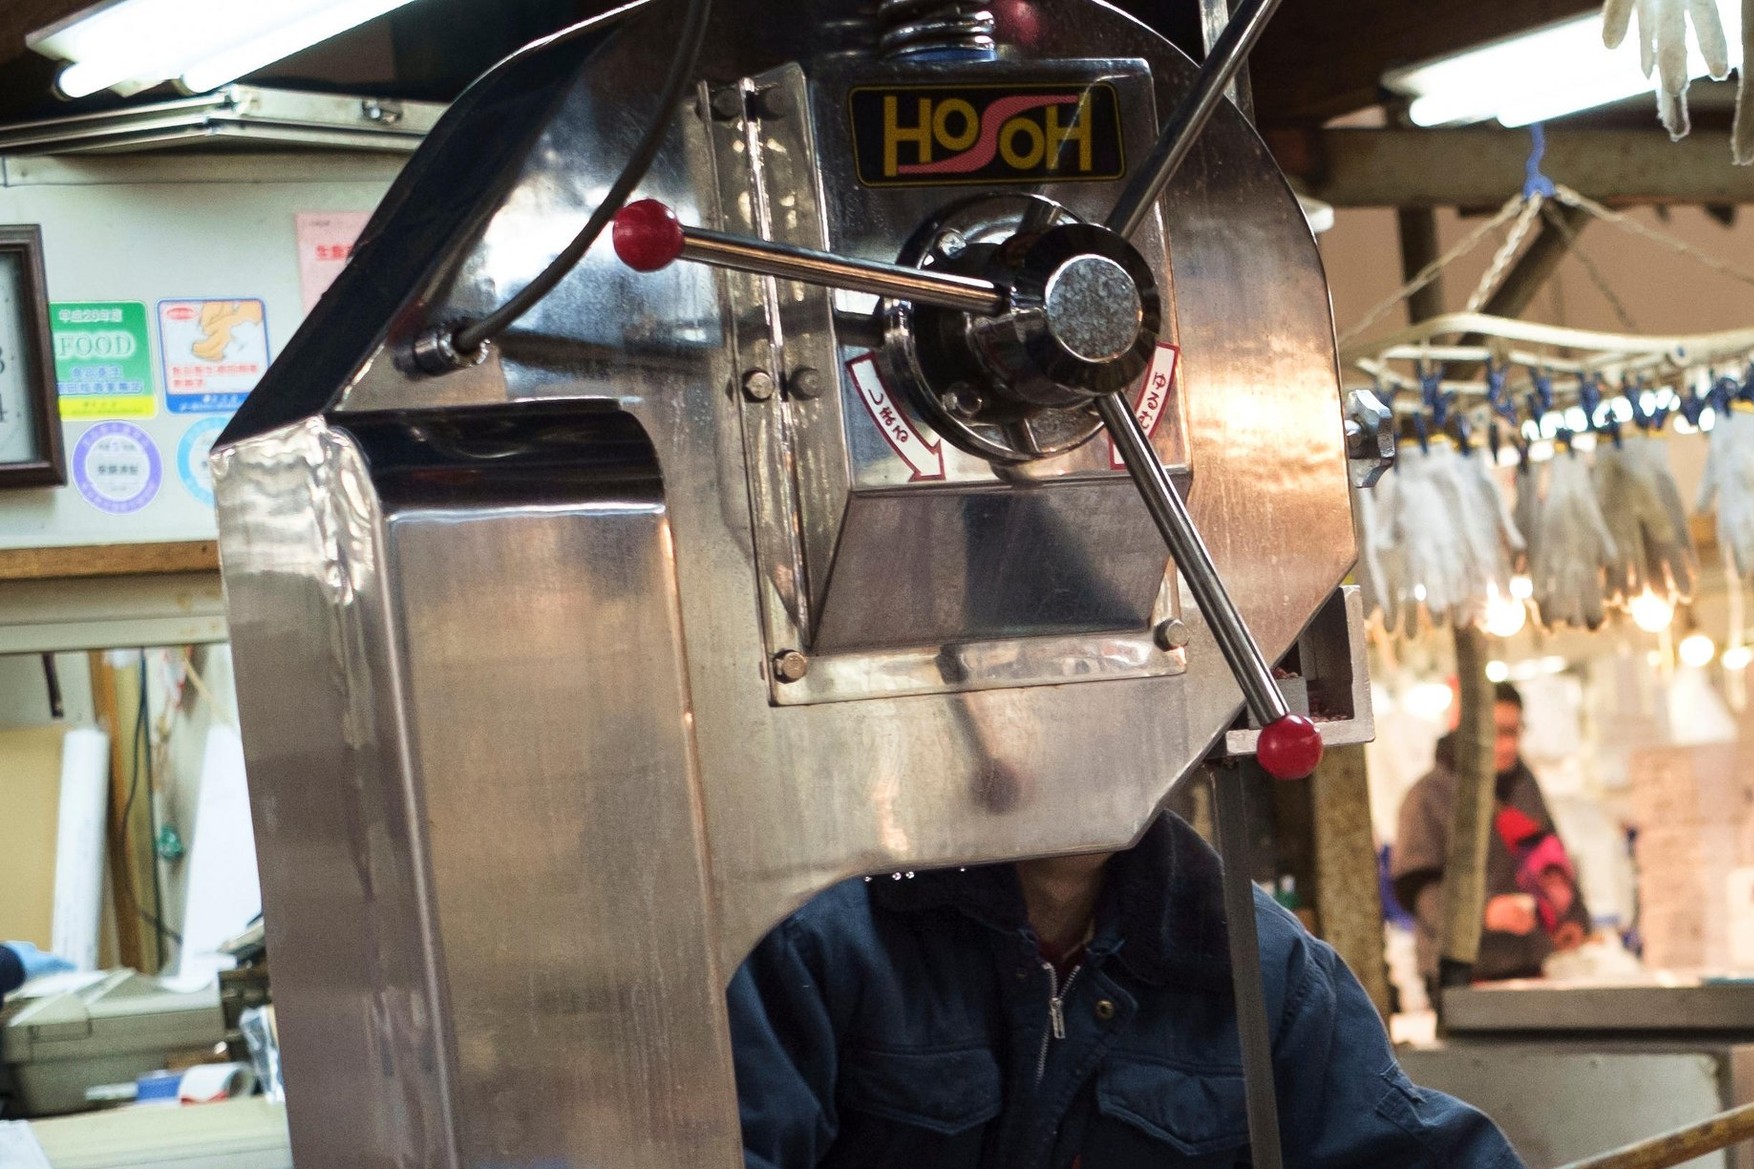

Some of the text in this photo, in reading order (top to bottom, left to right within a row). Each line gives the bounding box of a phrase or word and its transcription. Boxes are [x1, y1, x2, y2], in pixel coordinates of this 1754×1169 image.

[884, 92, 1092, 176] HOSOH
[59, 334, 132, 357] FOOD
[868, 389, 909, 443] しまる
[1139, 372, 1166, 429] ゆるむ
